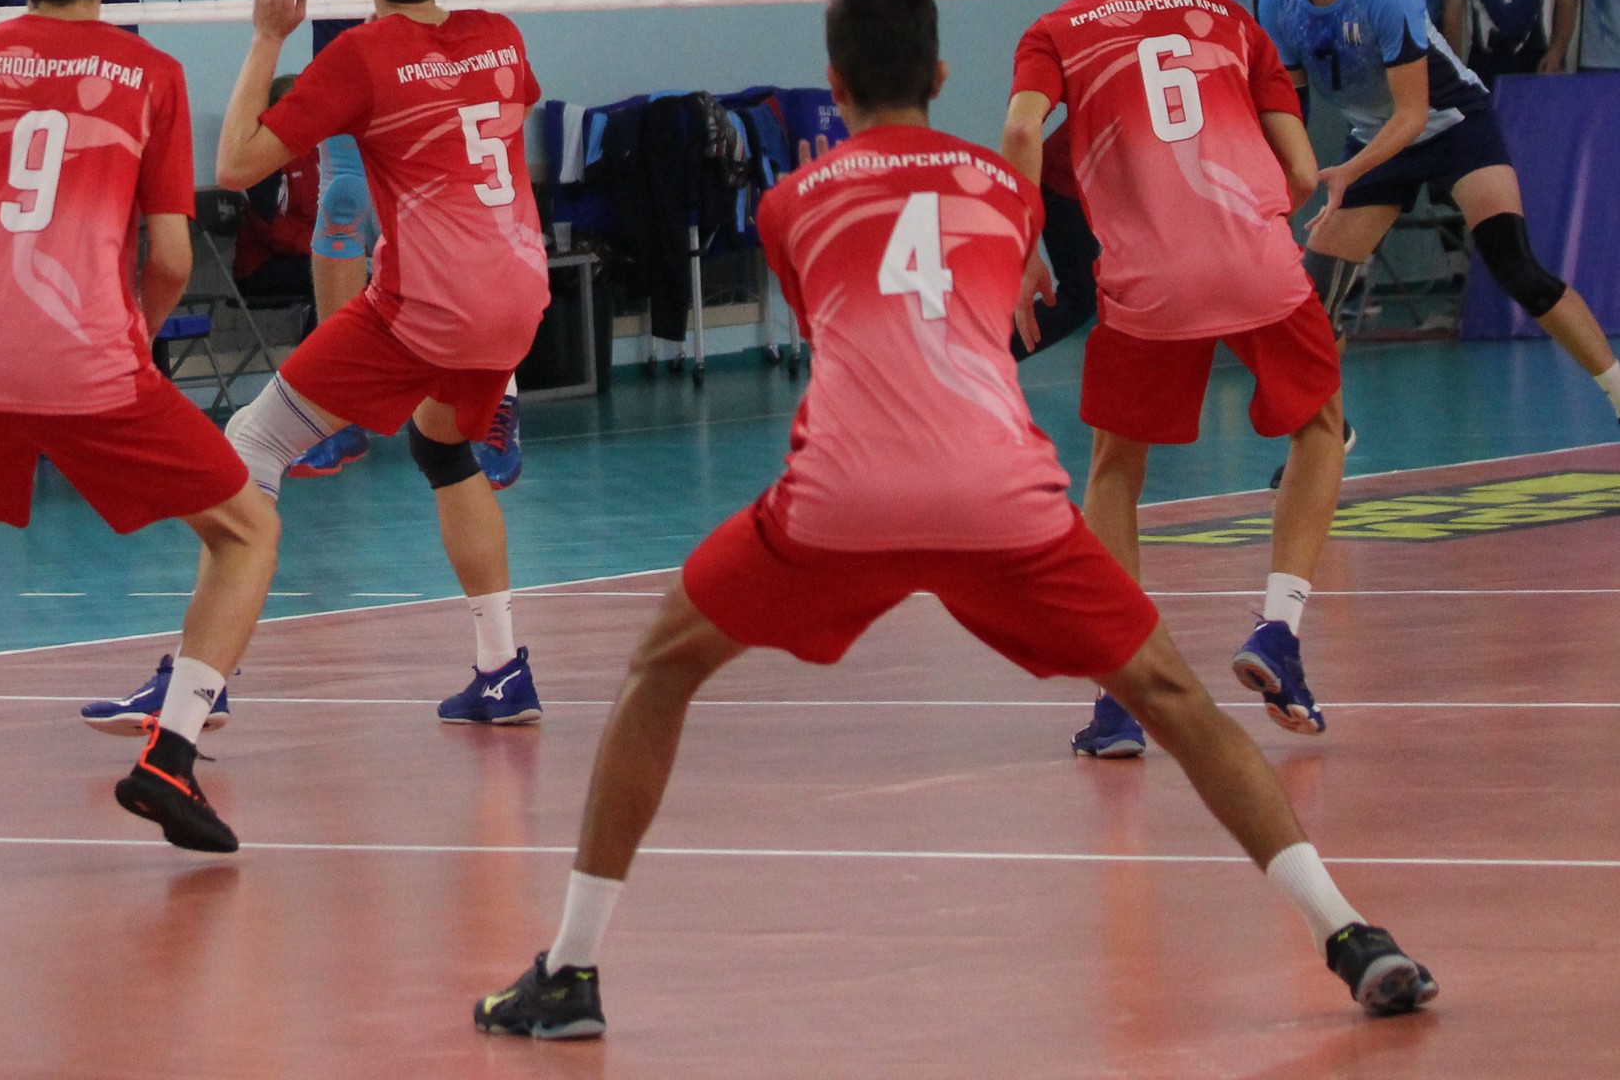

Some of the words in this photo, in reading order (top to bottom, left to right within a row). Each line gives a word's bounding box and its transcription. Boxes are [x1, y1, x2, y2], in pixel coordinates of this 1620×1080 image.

[100, 59, 144, 90] КРАЙ
[397, 49, 499, 84] КРАСНОДАРСКИЙ
[497, 45, 520, 67] КРАЙ
[1137, 34, 1205, 143] 6
[0, 109, 70, 234] 9
[458, 101, 516, 207] 5
[797, 151, 973, 196] КРАСНОДАРСКИЙ
[974, 157, 1020, 194] КРАЙ
[877, 191, 954, 320] 4
